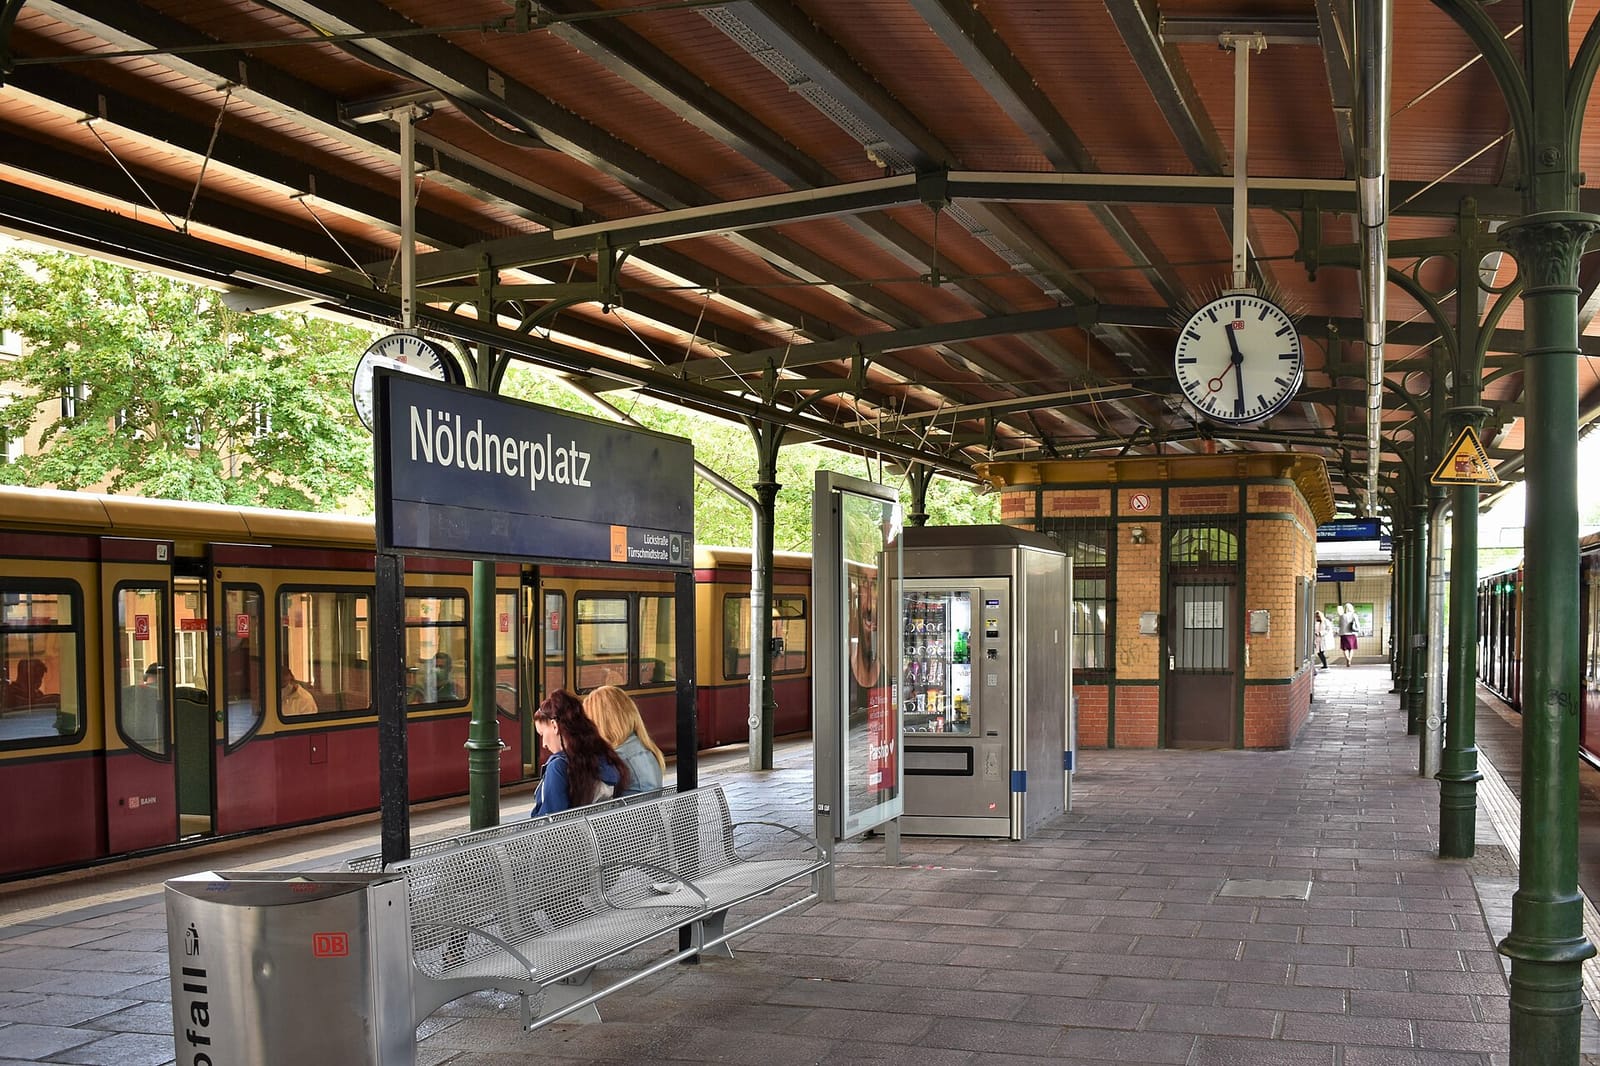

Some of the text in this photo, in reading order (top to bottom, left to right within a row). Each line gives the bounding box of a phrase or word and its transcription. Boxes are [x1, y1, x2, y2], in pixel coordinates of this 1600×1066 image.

[409, 405, 592, 491] Nöldnerplatz
[644, 534, 668, 546] Lückstraße
[314, 934, 348, 956] DB
